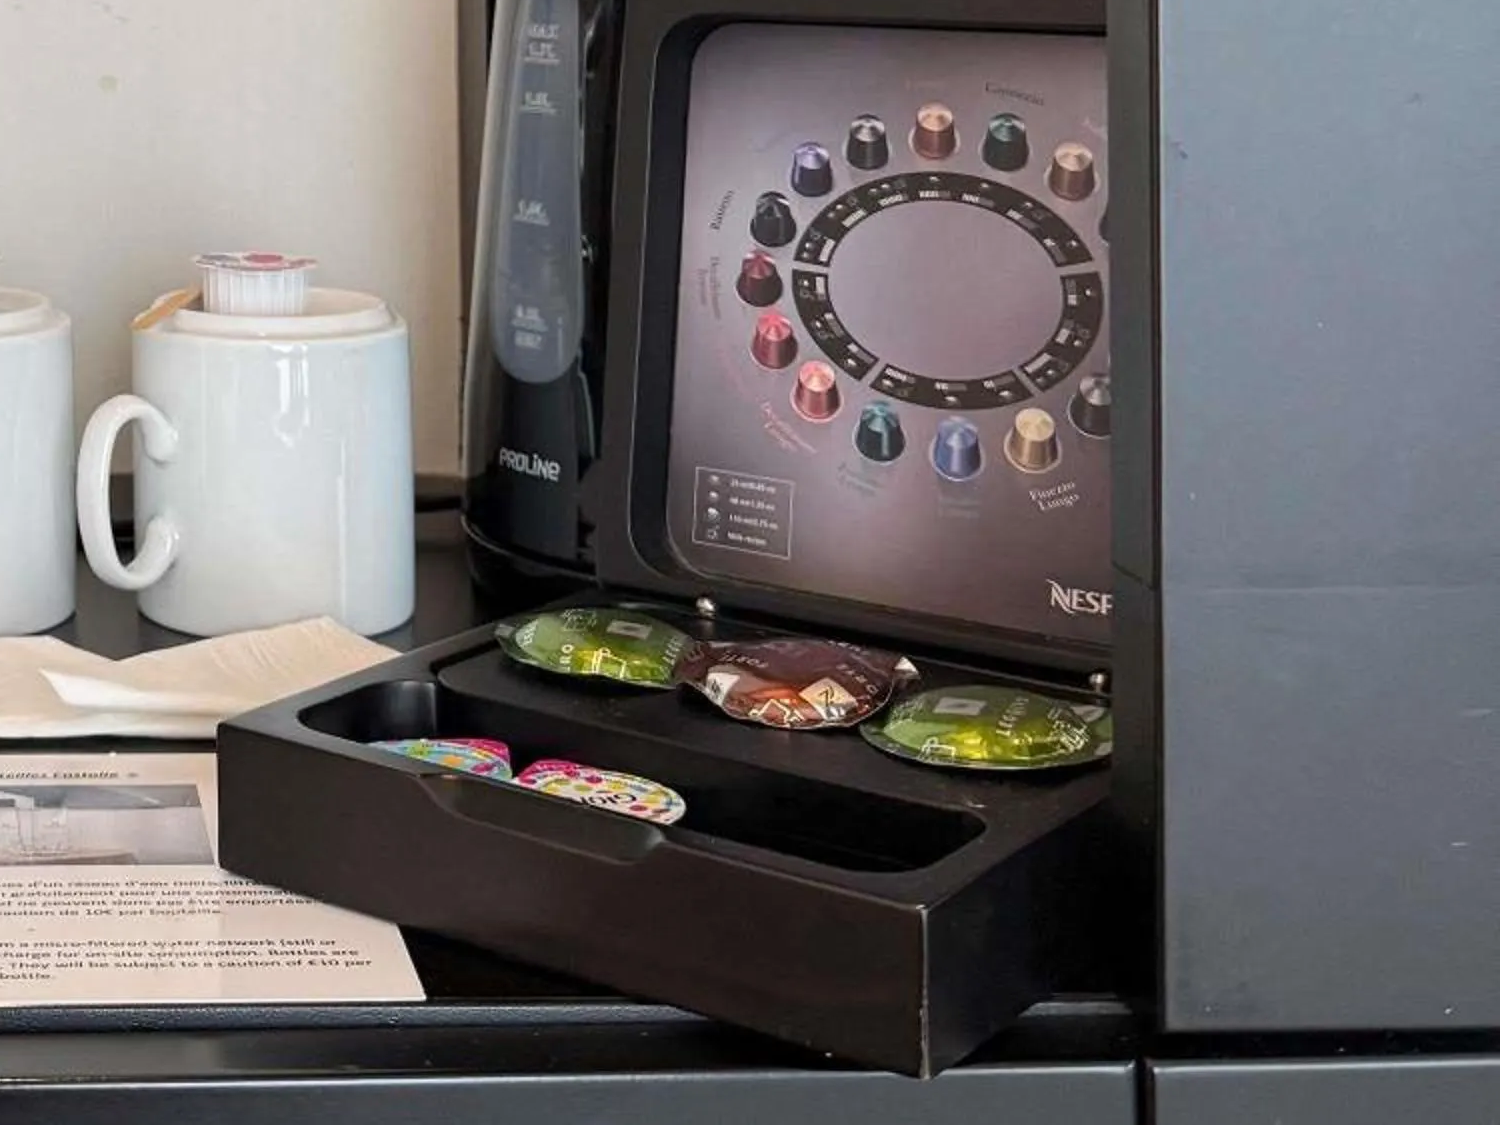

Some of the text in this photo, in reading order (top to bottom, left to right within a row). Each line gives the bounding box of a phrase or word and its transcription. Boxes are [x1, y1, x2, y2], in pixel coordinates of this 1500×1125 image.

[28, 879, 63, 888] d'un
[11, 889, 113, 899] gratuitement
[119, 890, 156, 898] pour
[42, 899, 106, 908] peuvent
[59, 908, 80, 916] de
[86, 908, 113, 916] 10€
[119, 908, 144, 916] par
[34, 940, 148, 948] micro-filtered
[208, 939, 275, 947] network
[56, 950, 80, 958] for
[85, 950, 143, 958] on-site
[8, 961, 50, 970] They
[55, 960, 84, 968] will
[88, 960, 109, 968] be
[114, 960, 176, 969] subject
[217, 959, 281, 967] caution
[308, 958, 340, 966] €10
[345, 959, 372, 968] per
